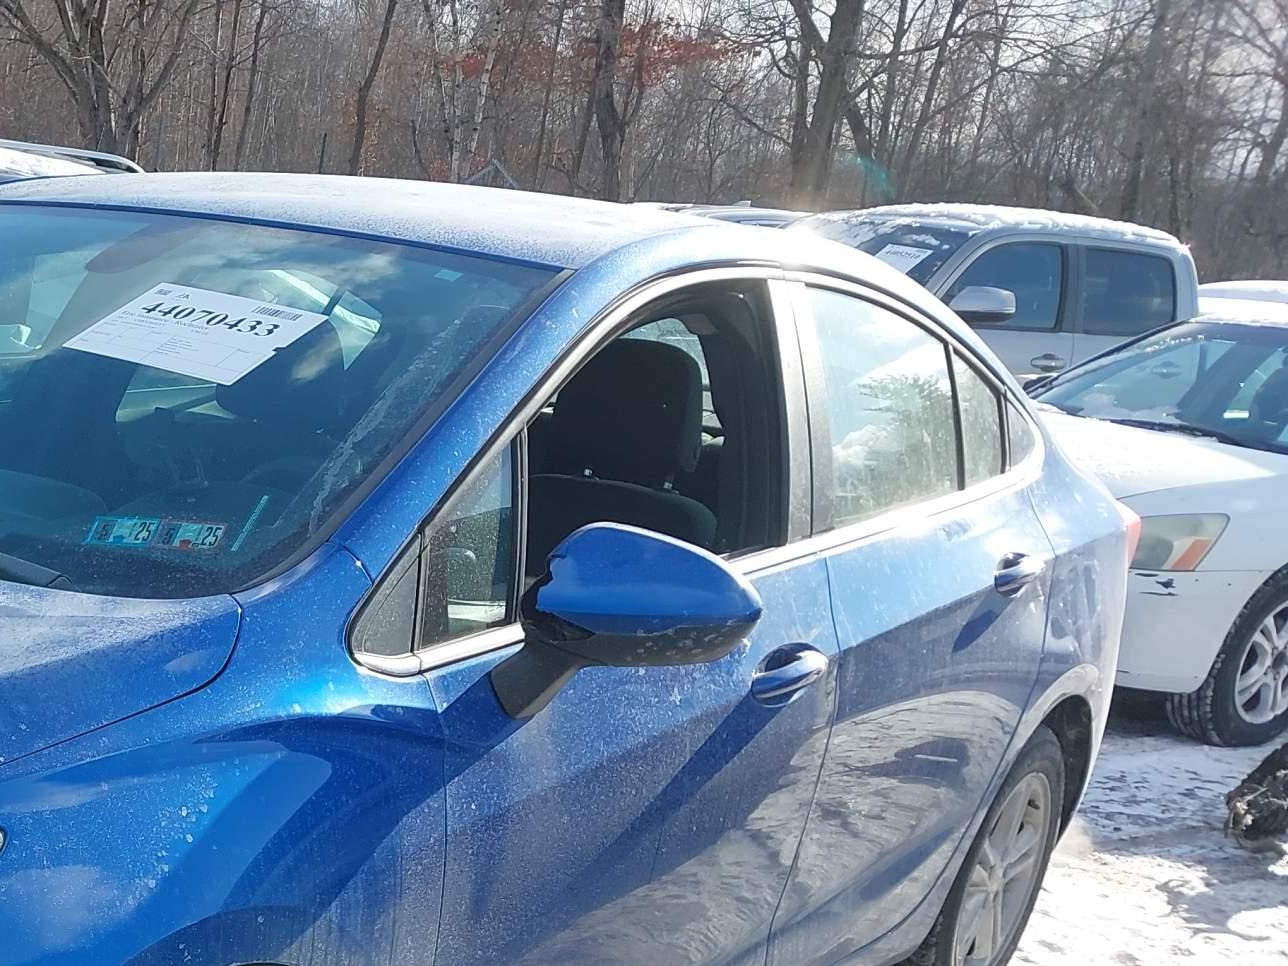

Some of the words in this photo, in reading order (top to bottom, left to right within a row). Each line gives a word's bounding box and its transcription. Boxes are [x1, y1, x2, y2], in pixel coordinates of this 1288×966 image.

[141, 301, 281, 337] 44070433
[134, 521, 155, 542] 25
[200, 526, 223, 547] 25
